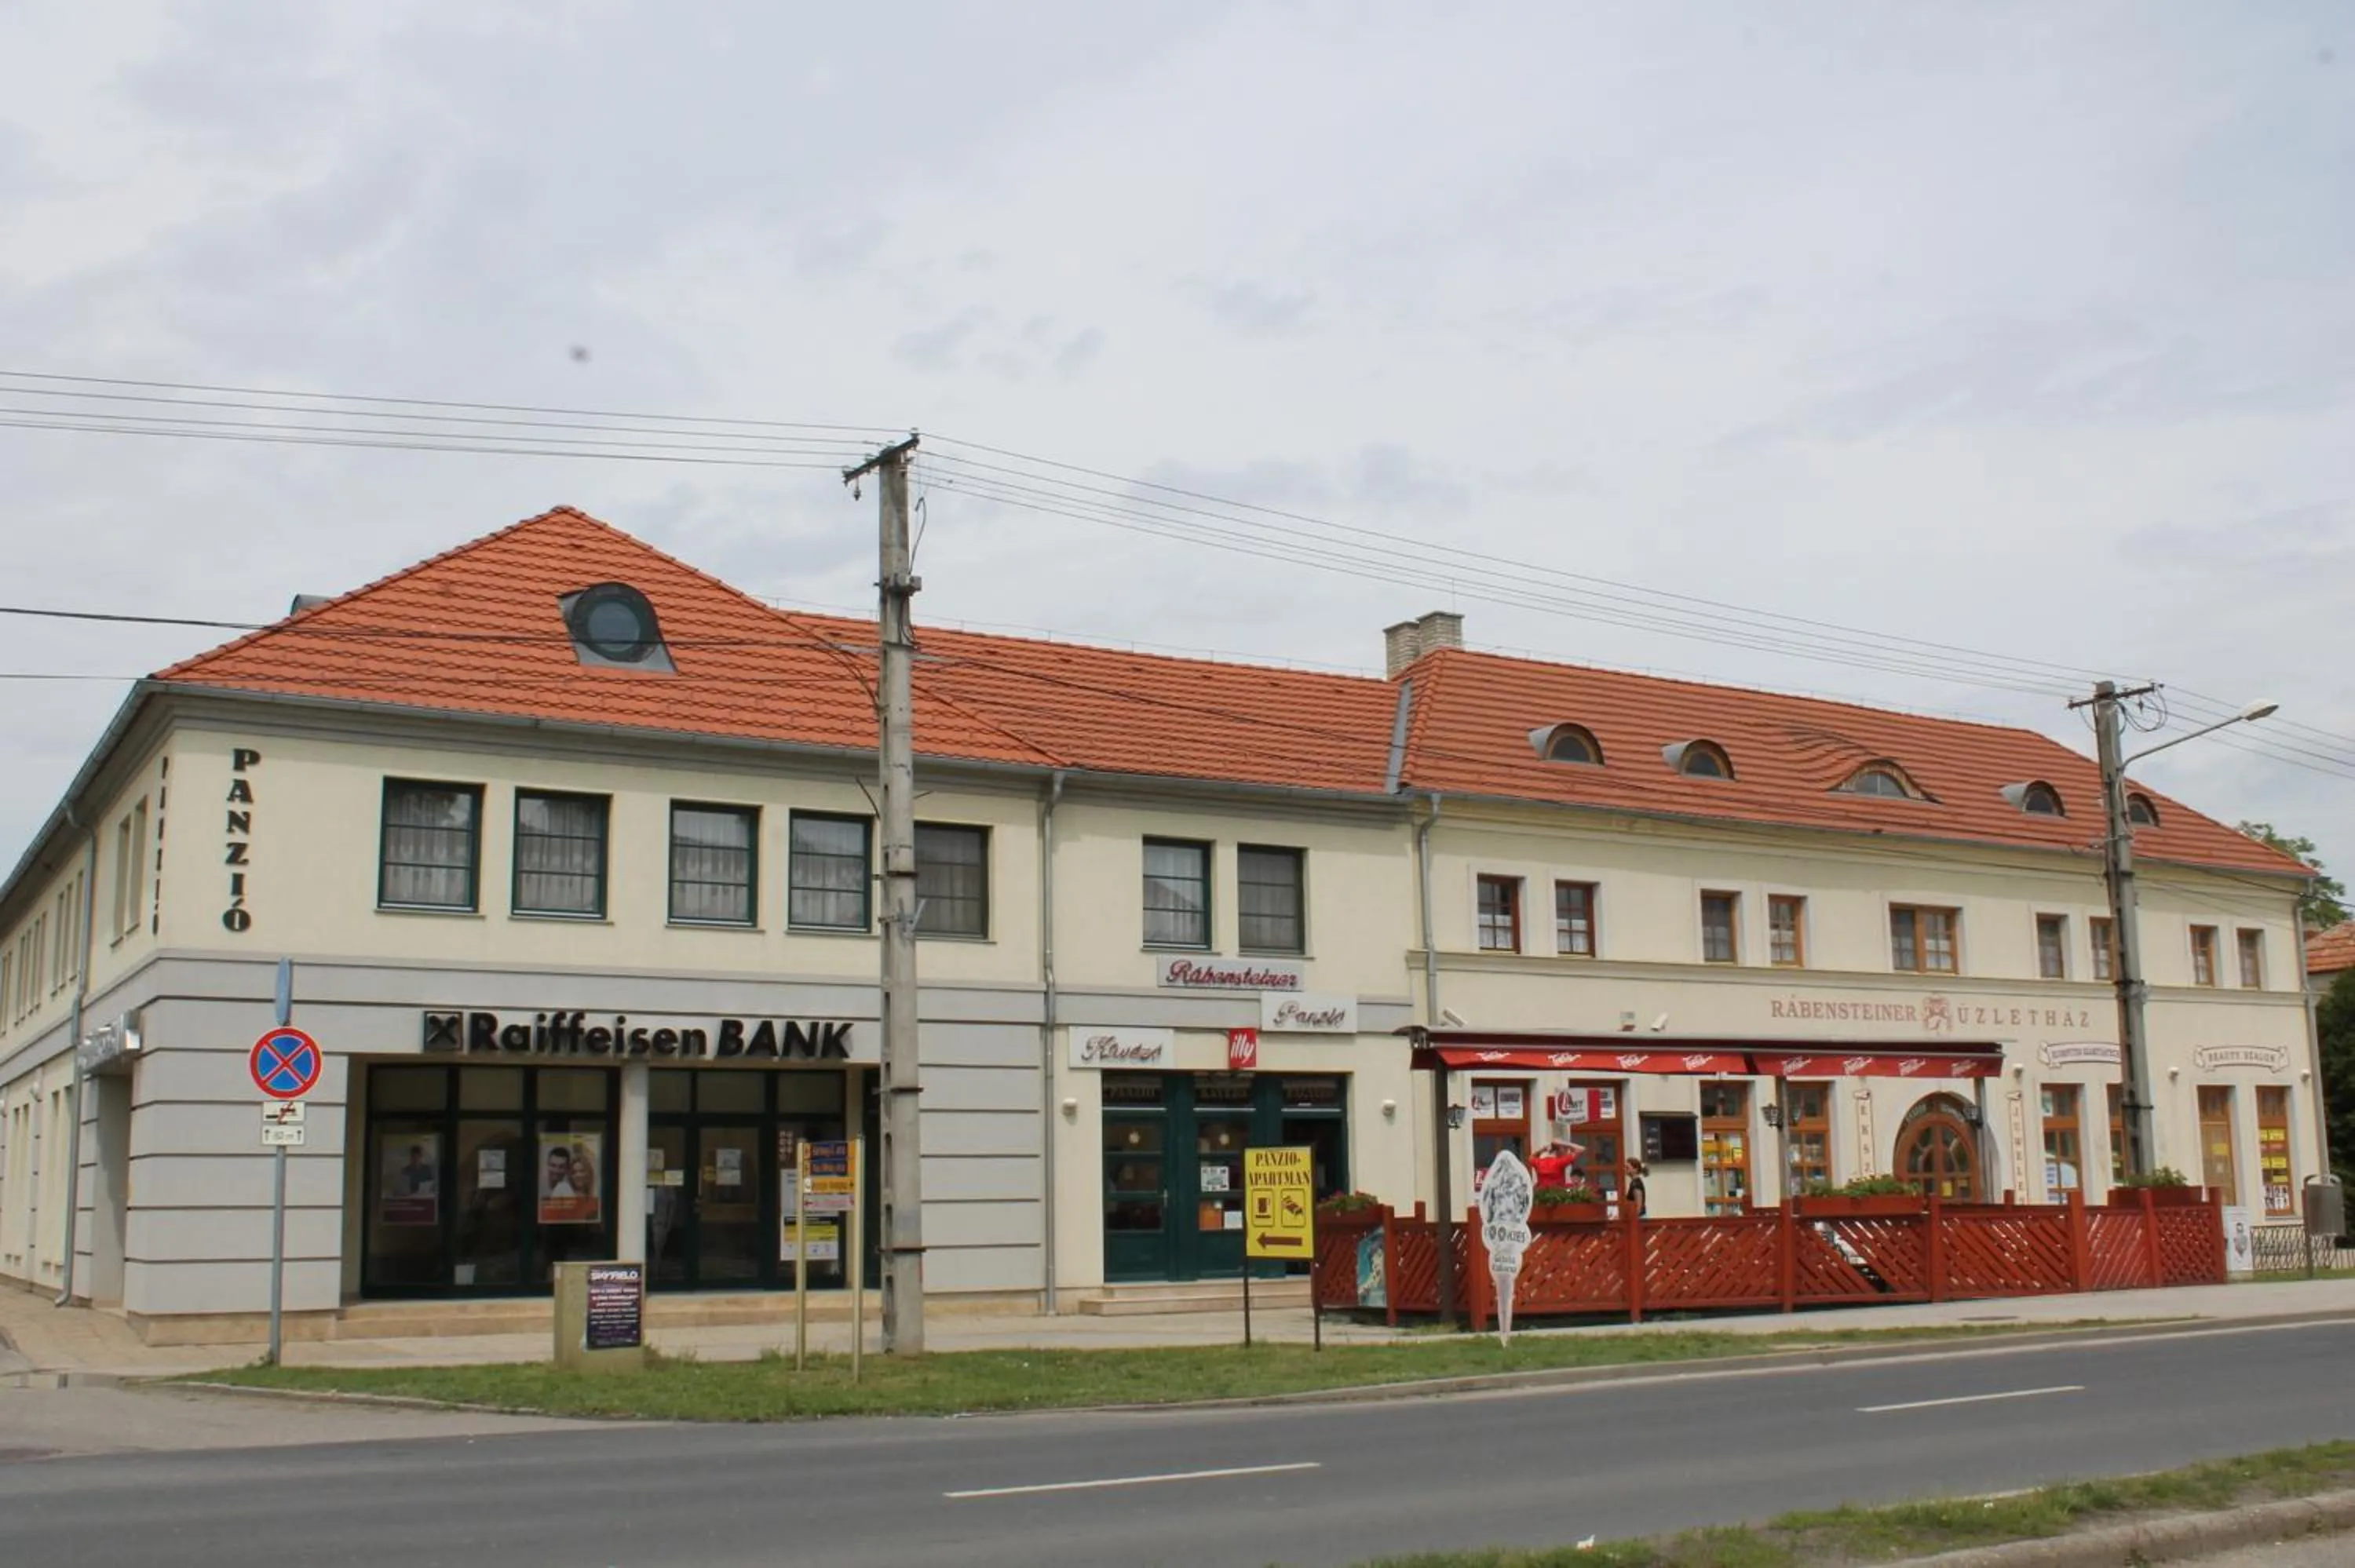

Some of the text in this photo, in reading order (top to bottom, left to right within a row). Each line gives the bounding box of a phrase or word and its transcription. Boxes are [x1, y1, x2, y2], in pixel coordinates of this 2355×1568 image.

[221, 748, 261, 933] PANZIÓ
[1770, 994, 2090, 1027] RÁBENSTEINER ÜZLETHÁZ
[469, 1011, 855, 1059] Raiffeisen BANK
[1231, 1034, 1254, 1064] illy
